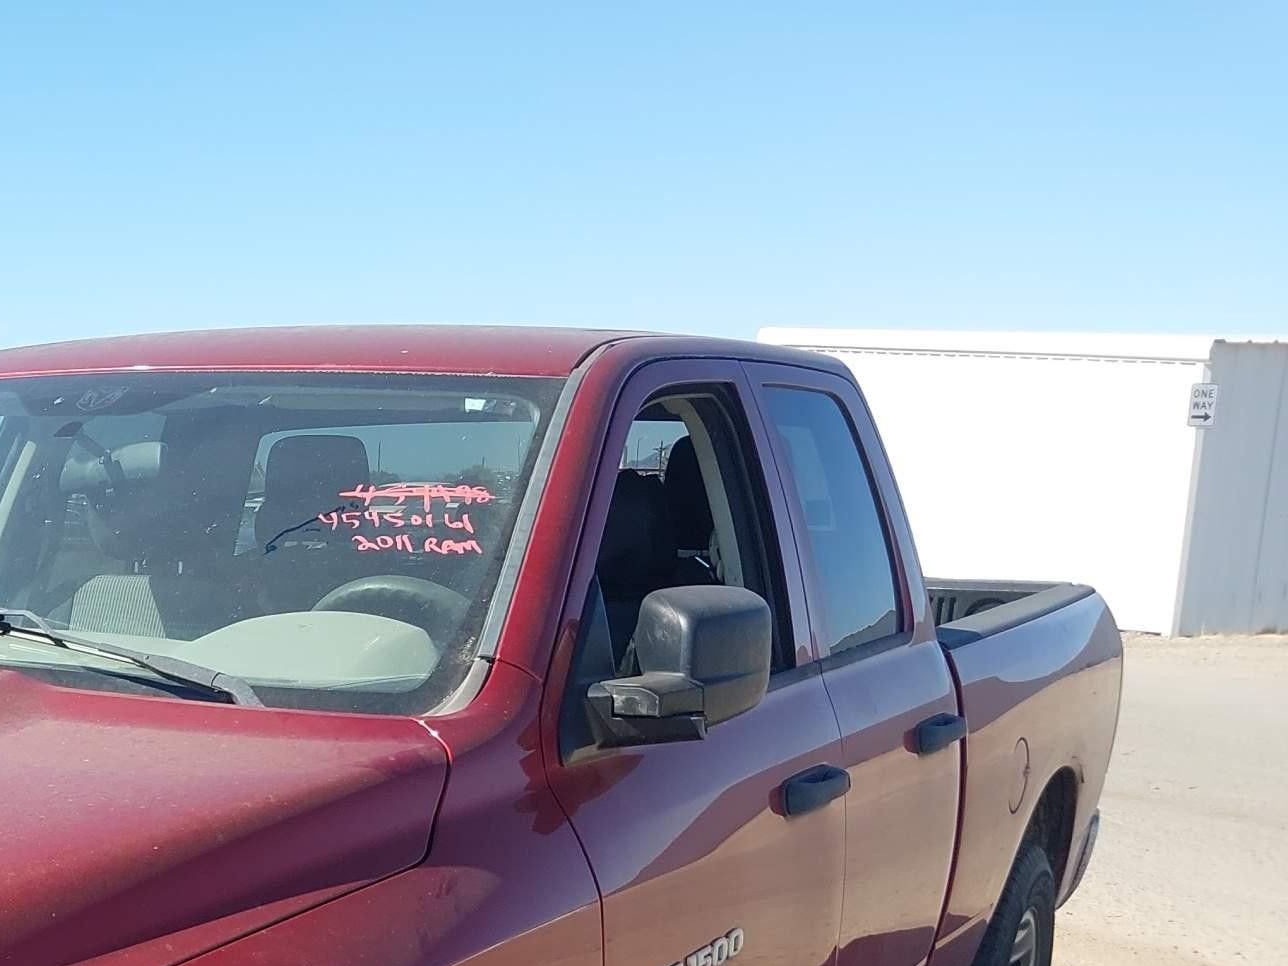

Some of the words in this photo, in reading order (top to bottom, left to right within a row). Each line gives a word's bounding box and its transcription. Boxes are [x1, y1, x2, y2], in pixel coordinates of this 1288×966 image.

[1193, 388, 1215, 399] ONE
[1192, 401, 1214, 411] WAY
[352, 534, 413, 552] 2011
